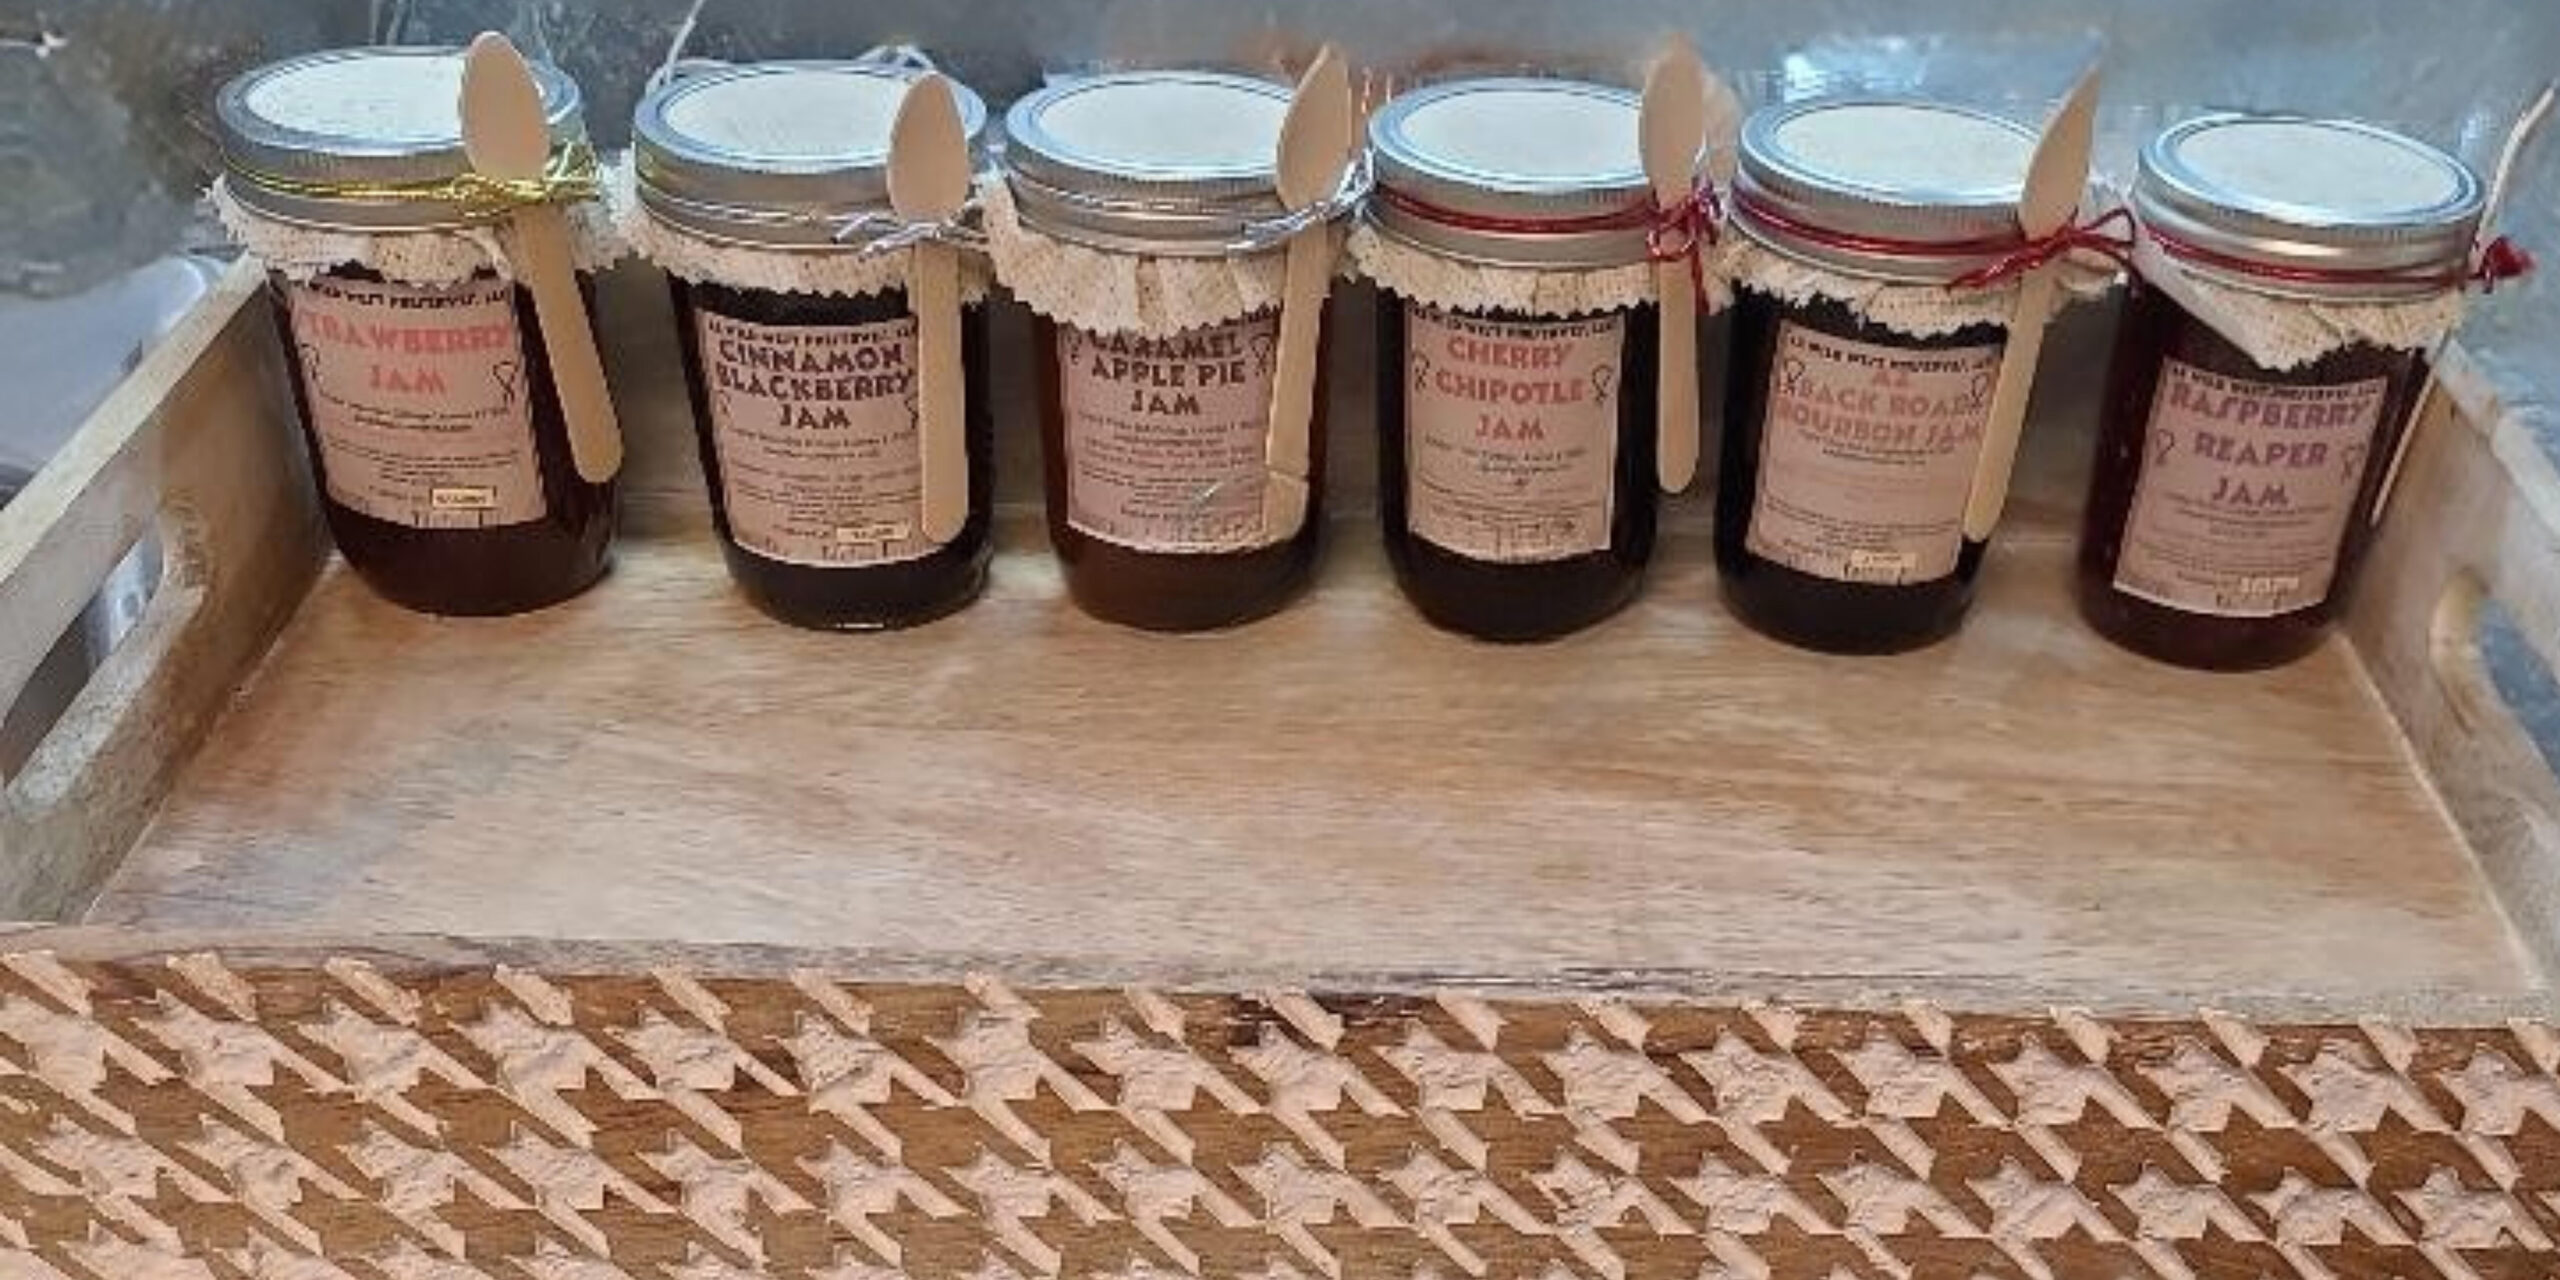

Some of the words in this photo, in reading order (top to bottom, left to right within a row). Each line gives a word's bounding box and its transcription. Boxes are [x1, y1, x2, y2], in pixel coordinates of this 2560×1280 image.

[718, 339, 905, 373] CINNAMON
[1447, 336, 1574, 370] CHERRY
[369, 365, 447, 394] JAM
[716, 362, 914, 400] BLACKBERRY
[1091, 354, 1185, 387] APPLE
[1198, 361, 1246, 387] PIE
[1435, 368, 1585, 405] CHIPOTLE
[779, 403, 852, 430] JAM
[1131, 390, 1200, 416] JAM
[2169, 383, 2371, 429] RASPBERRY
[1475, 415, 1544, 440] JAM
[1777, 398, 1917, 442] BOURBON
[1925, 424, 1981, 449] JAM
[2195, 431, 2328, 468] REAPER
[2211, 478, 2289, 506] JAM
